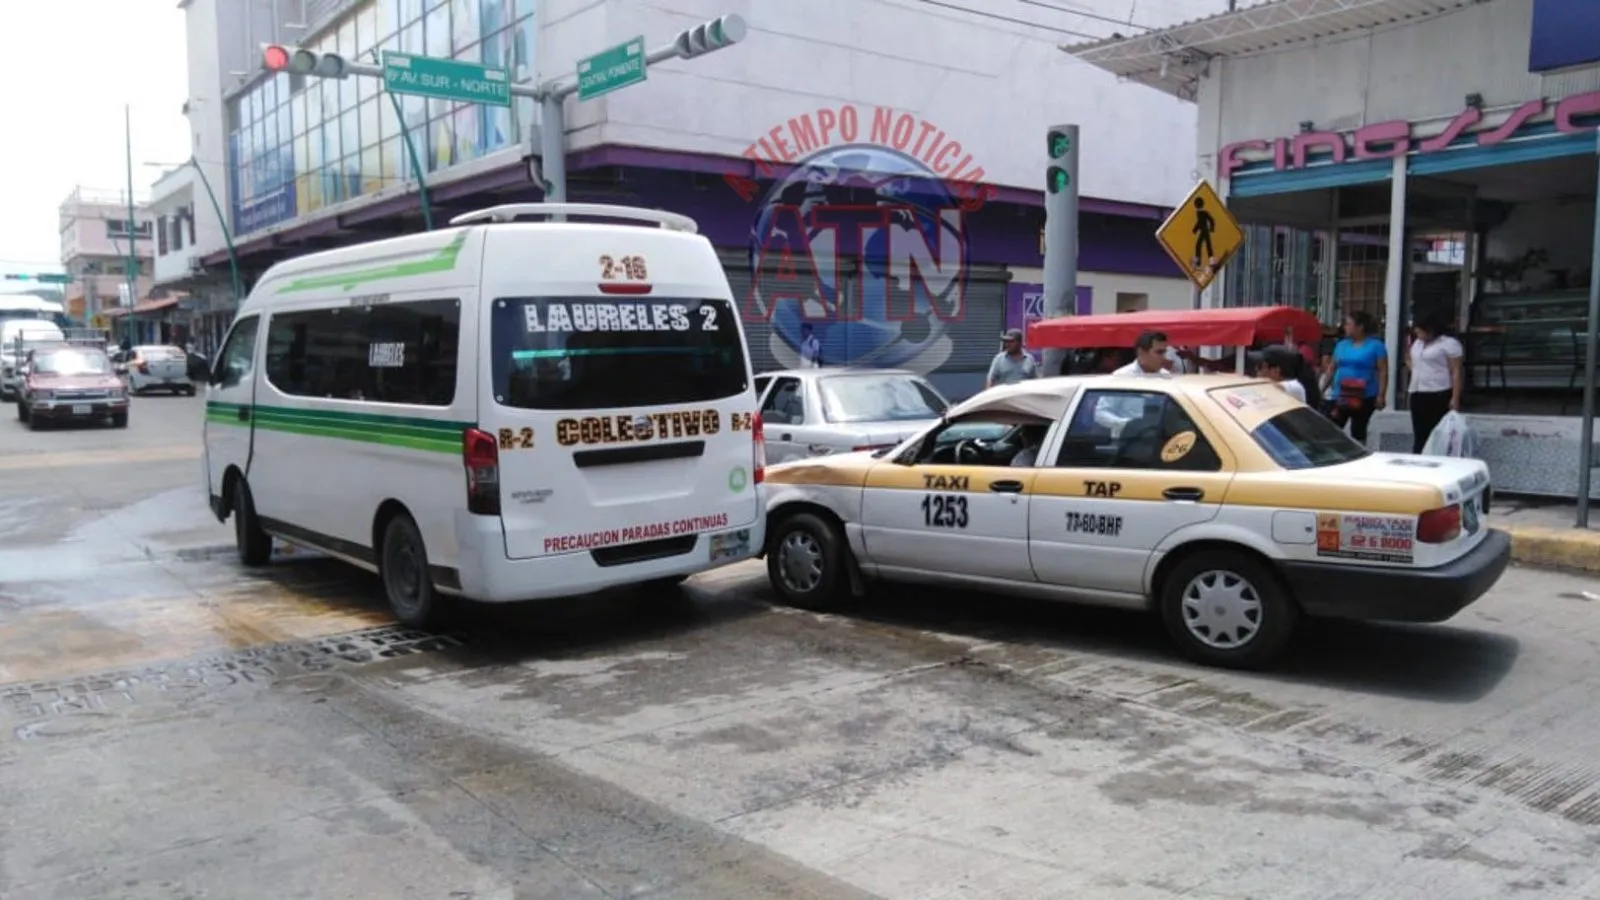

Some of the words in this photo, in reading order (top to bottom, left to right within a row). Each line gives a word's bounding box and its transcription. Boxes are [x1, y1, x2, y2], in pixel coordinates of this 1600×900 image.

[421, 73, 450, 89] SUR
[462, 79, 505, 97] NORTE
[524, 303, 690, 332] LAURELES
[700, 305, 719, 331] 2
[499, 427, 534, 450] R-2
[731, 411, 752, 431] R-2
[923, 474, 969, 490] TAXI
[1083, 481, 1122, 497] TAP
[921, 495, 968, 529] 1253
[544, 530, 620, 553] PRECAUCION
[622, 522, 671, 541] PARADAS
[672, 513, 729, 534] CONTINUAS
